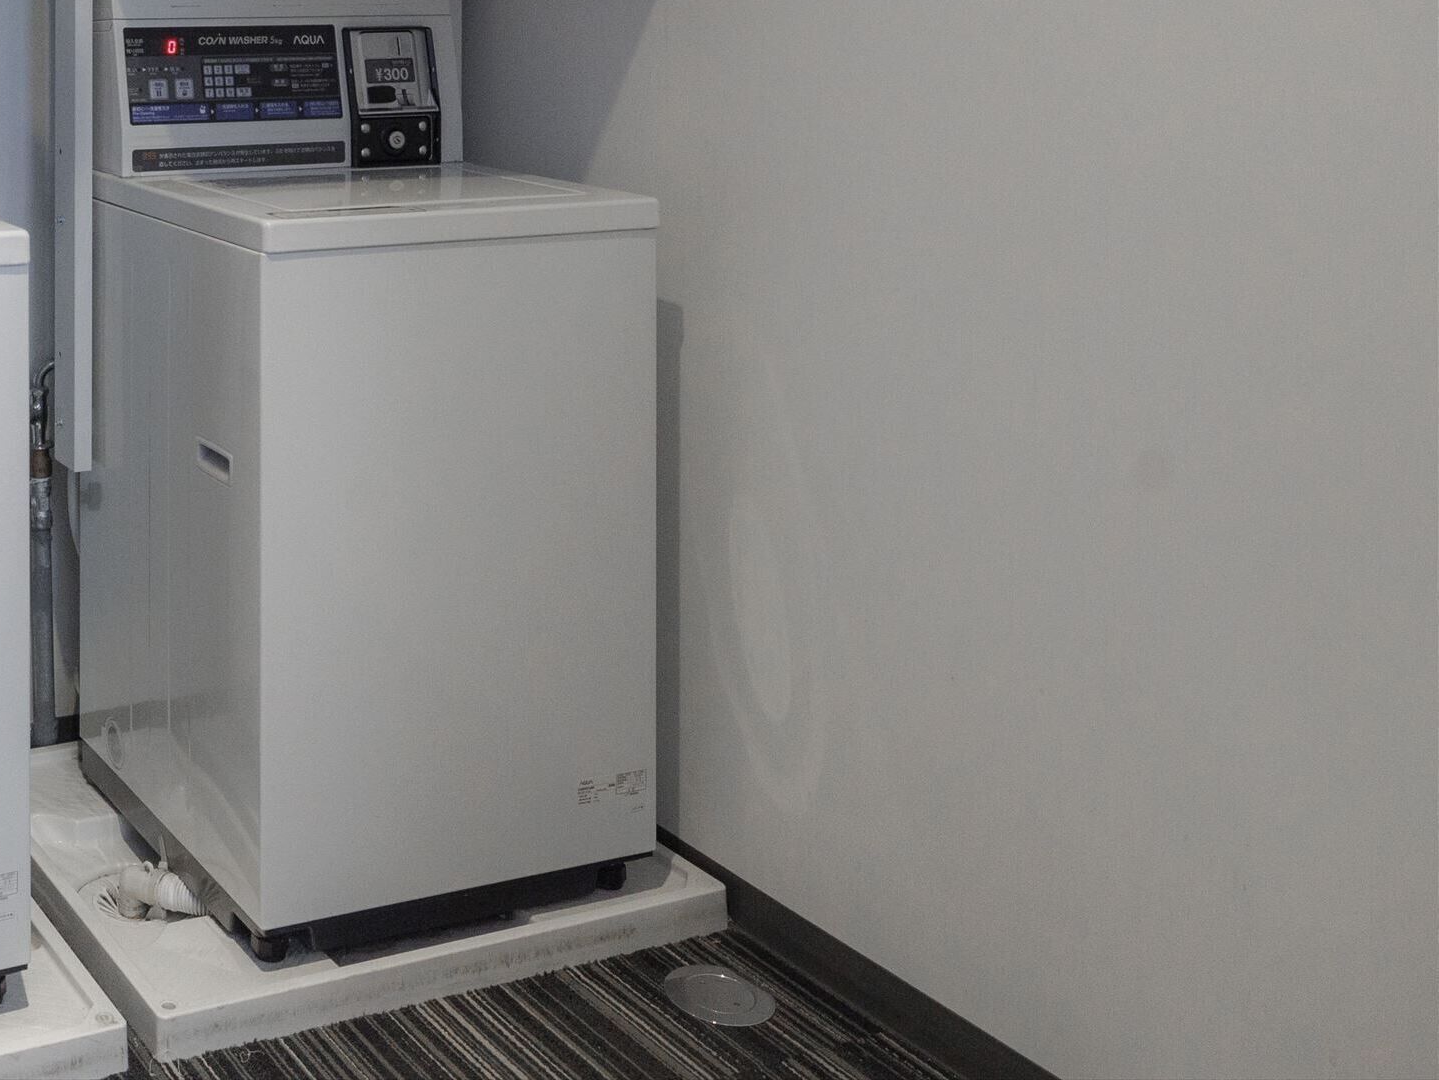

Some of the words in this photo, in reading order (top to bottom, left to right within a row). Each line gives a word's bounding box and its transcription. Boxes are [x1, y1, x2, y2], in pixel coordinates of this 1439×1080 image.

[198, 33, 227, 46] COIN
[228, 35, 269, 45] WASHER
[293, 34, 325, 45] AQUA
[167, 40, 177, 54] 0
[375, 67, 409, 82] ¥300
